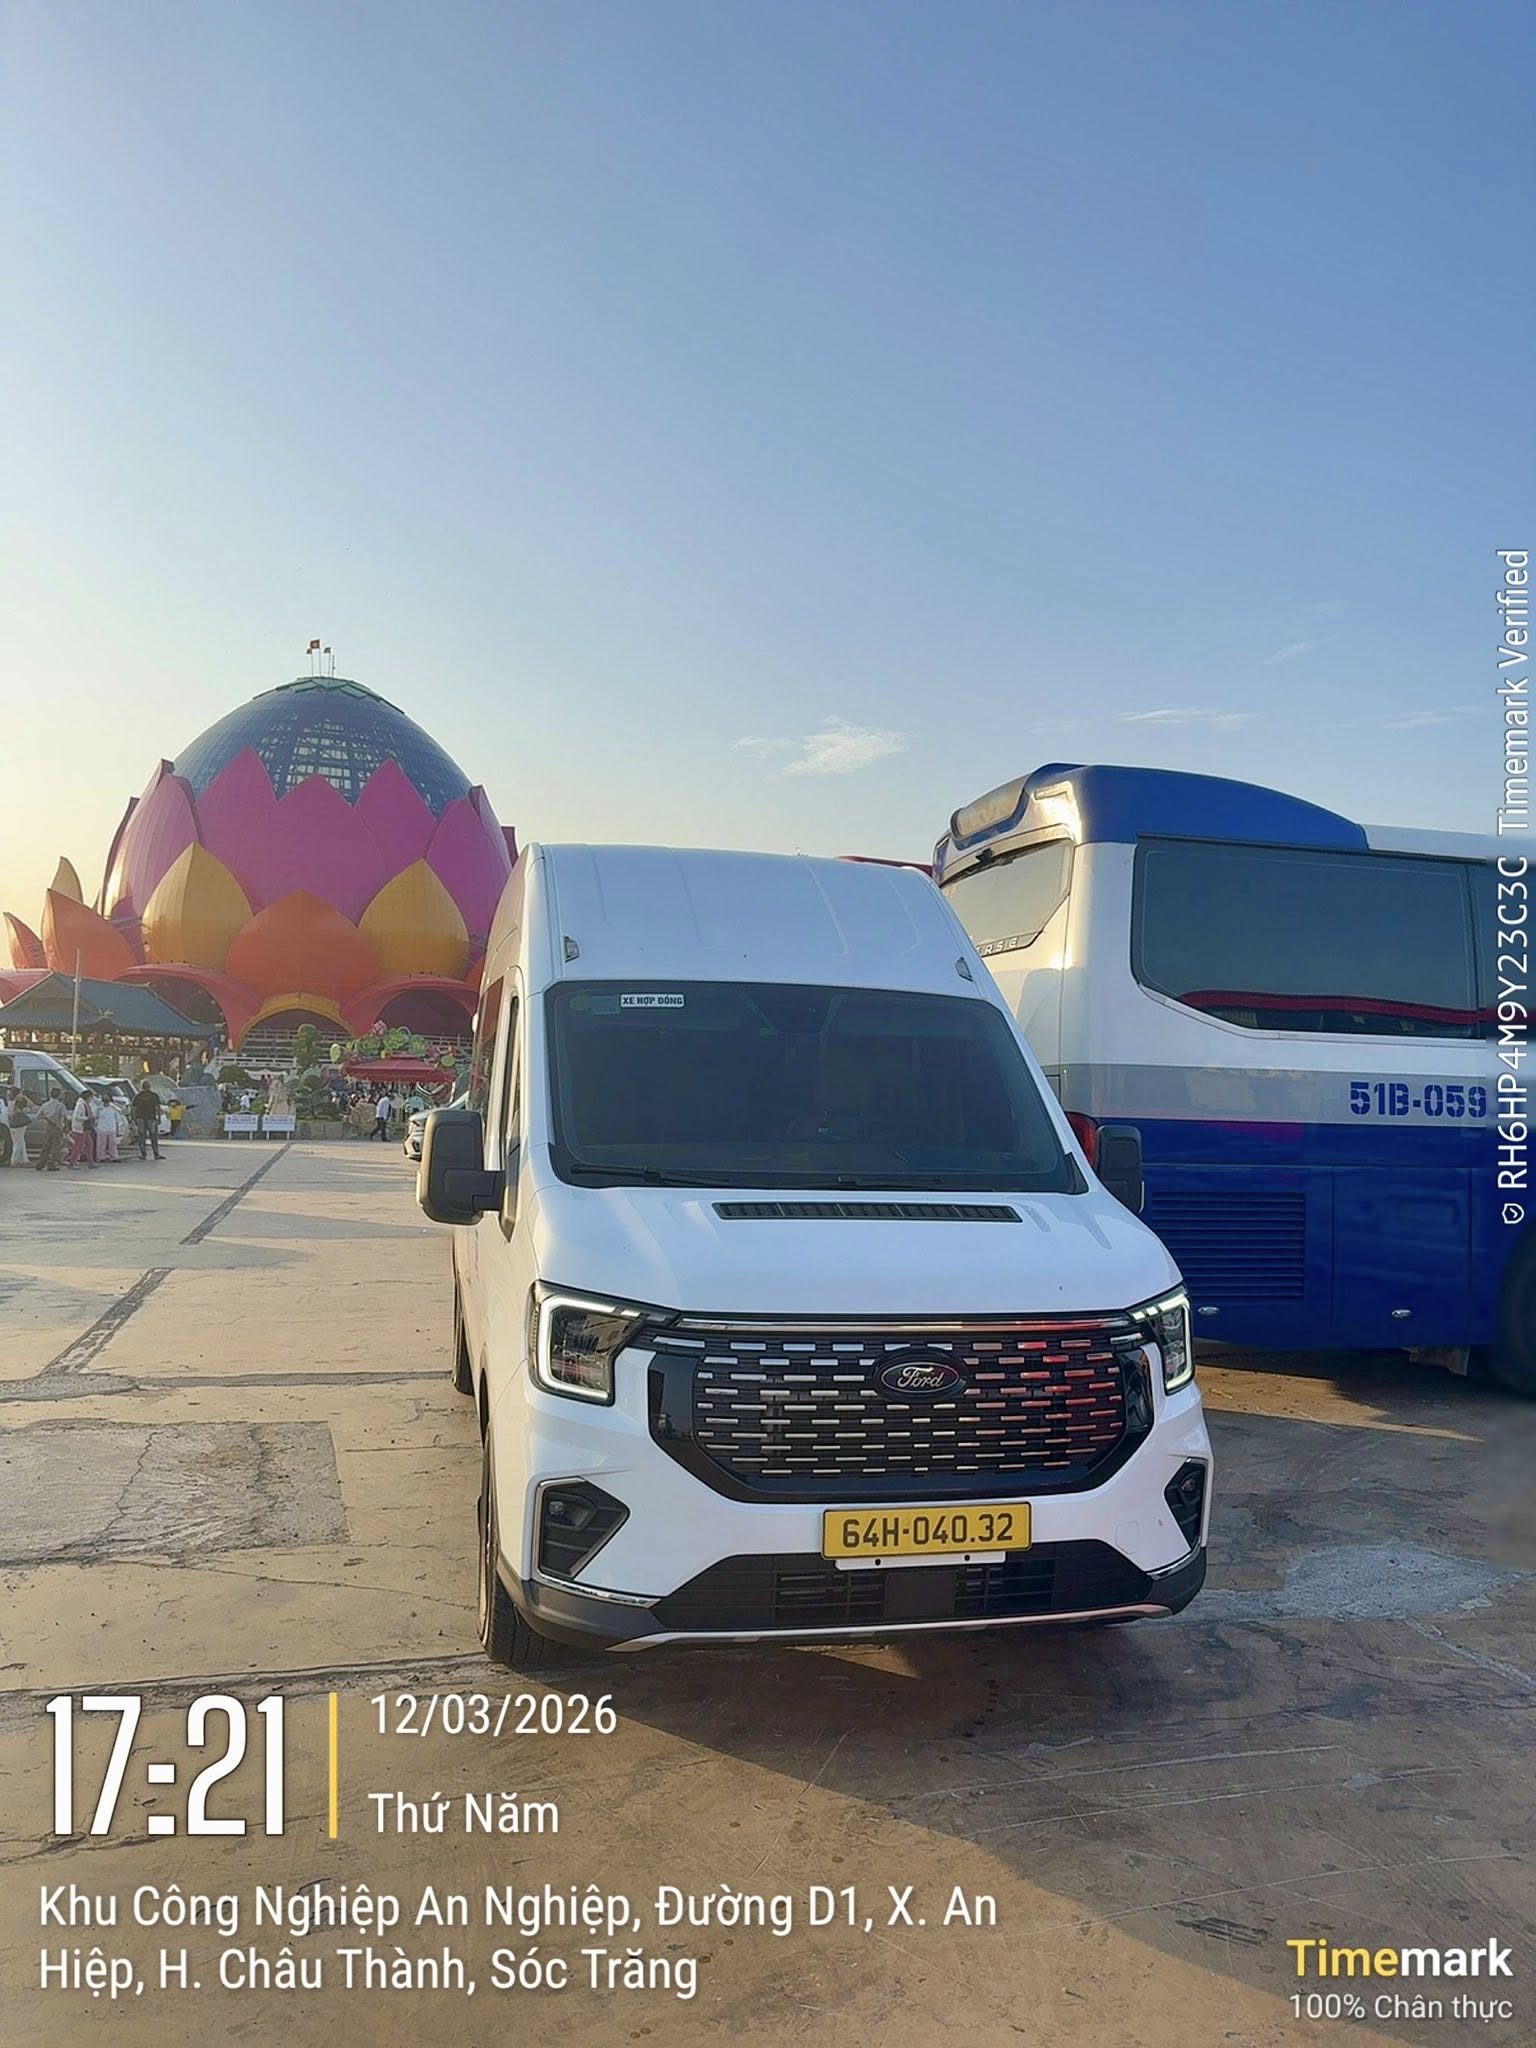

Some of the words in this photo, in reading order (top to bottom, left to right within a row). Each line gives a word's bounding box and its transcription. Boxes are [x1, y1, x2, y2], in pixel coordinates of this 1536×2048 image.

[623, 996, 635, 1005] XE
[1350, 1081, 1488, 1118] 51B-059
[897, 1366, 945, 1388] Ford
[842, 1513, 1013, 1548] 64H-040.32
